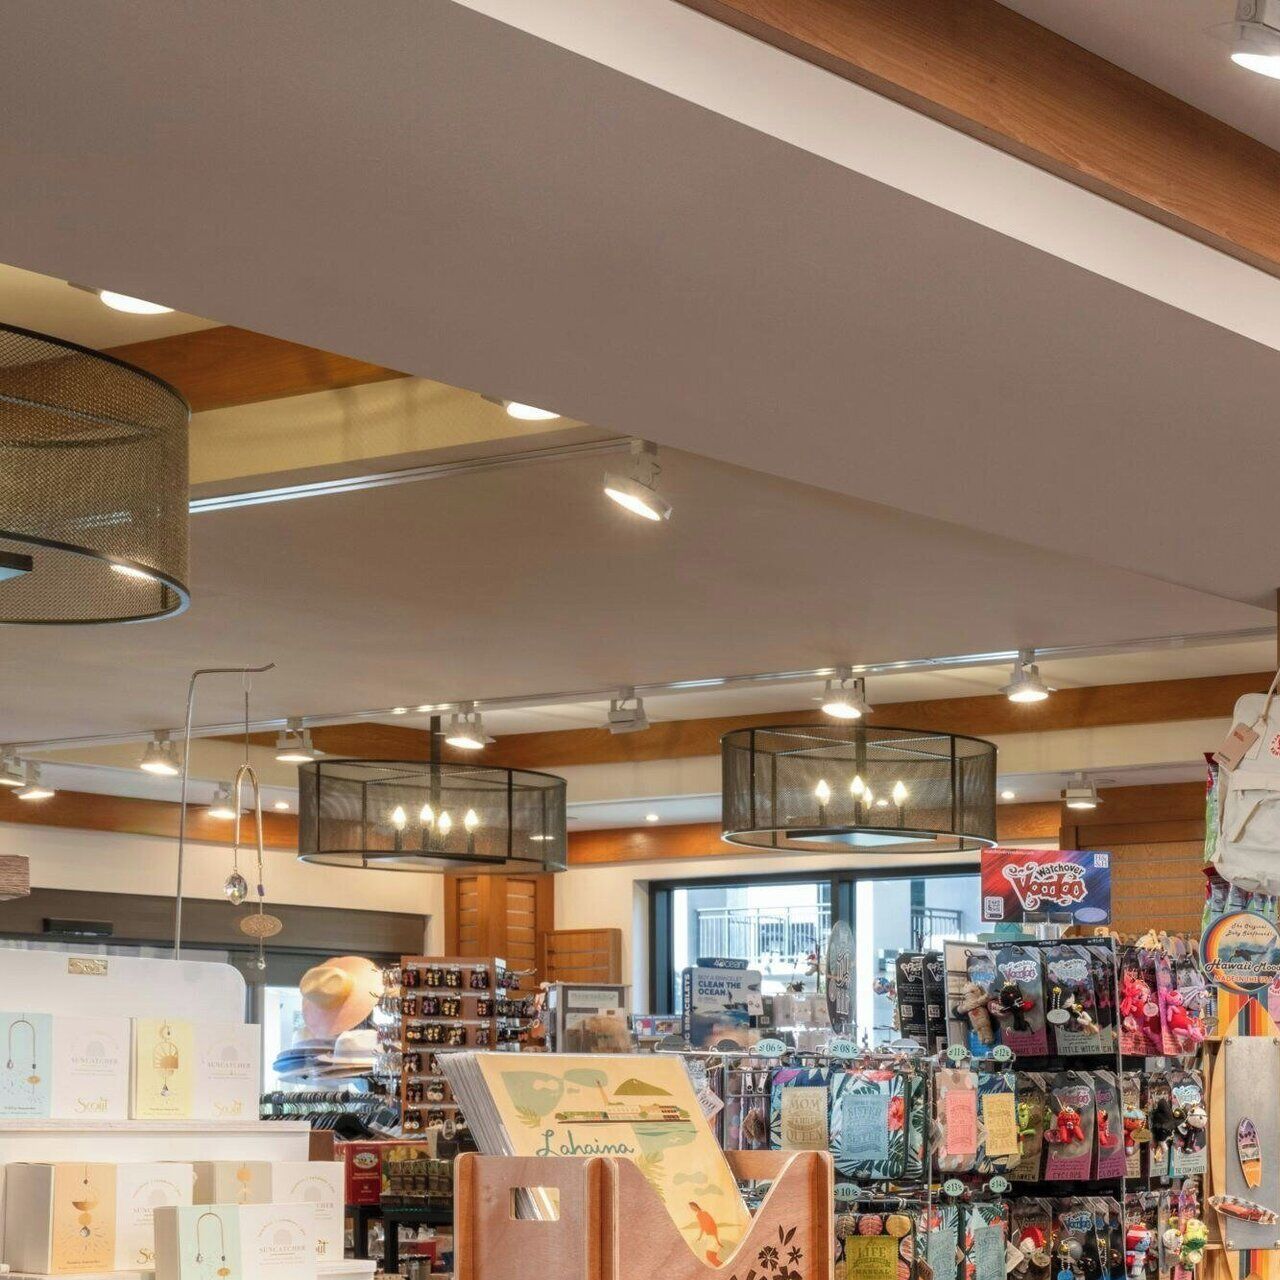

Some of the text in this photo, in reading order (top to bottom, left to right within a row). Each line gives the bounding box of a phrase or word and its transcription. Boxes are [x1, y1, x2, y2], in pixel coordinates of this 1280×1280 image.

[1204, 958, 1252, 972] Hawaii
[698, 981, 742, 989] CLEAN THE
[789, 1098, 821, 1110] MOM
[786, 1128, 823, 1142] QUEEN
[535, 1129, 635, 1158] Lahaina
[857, 1246, 887, 1258] LIFE
